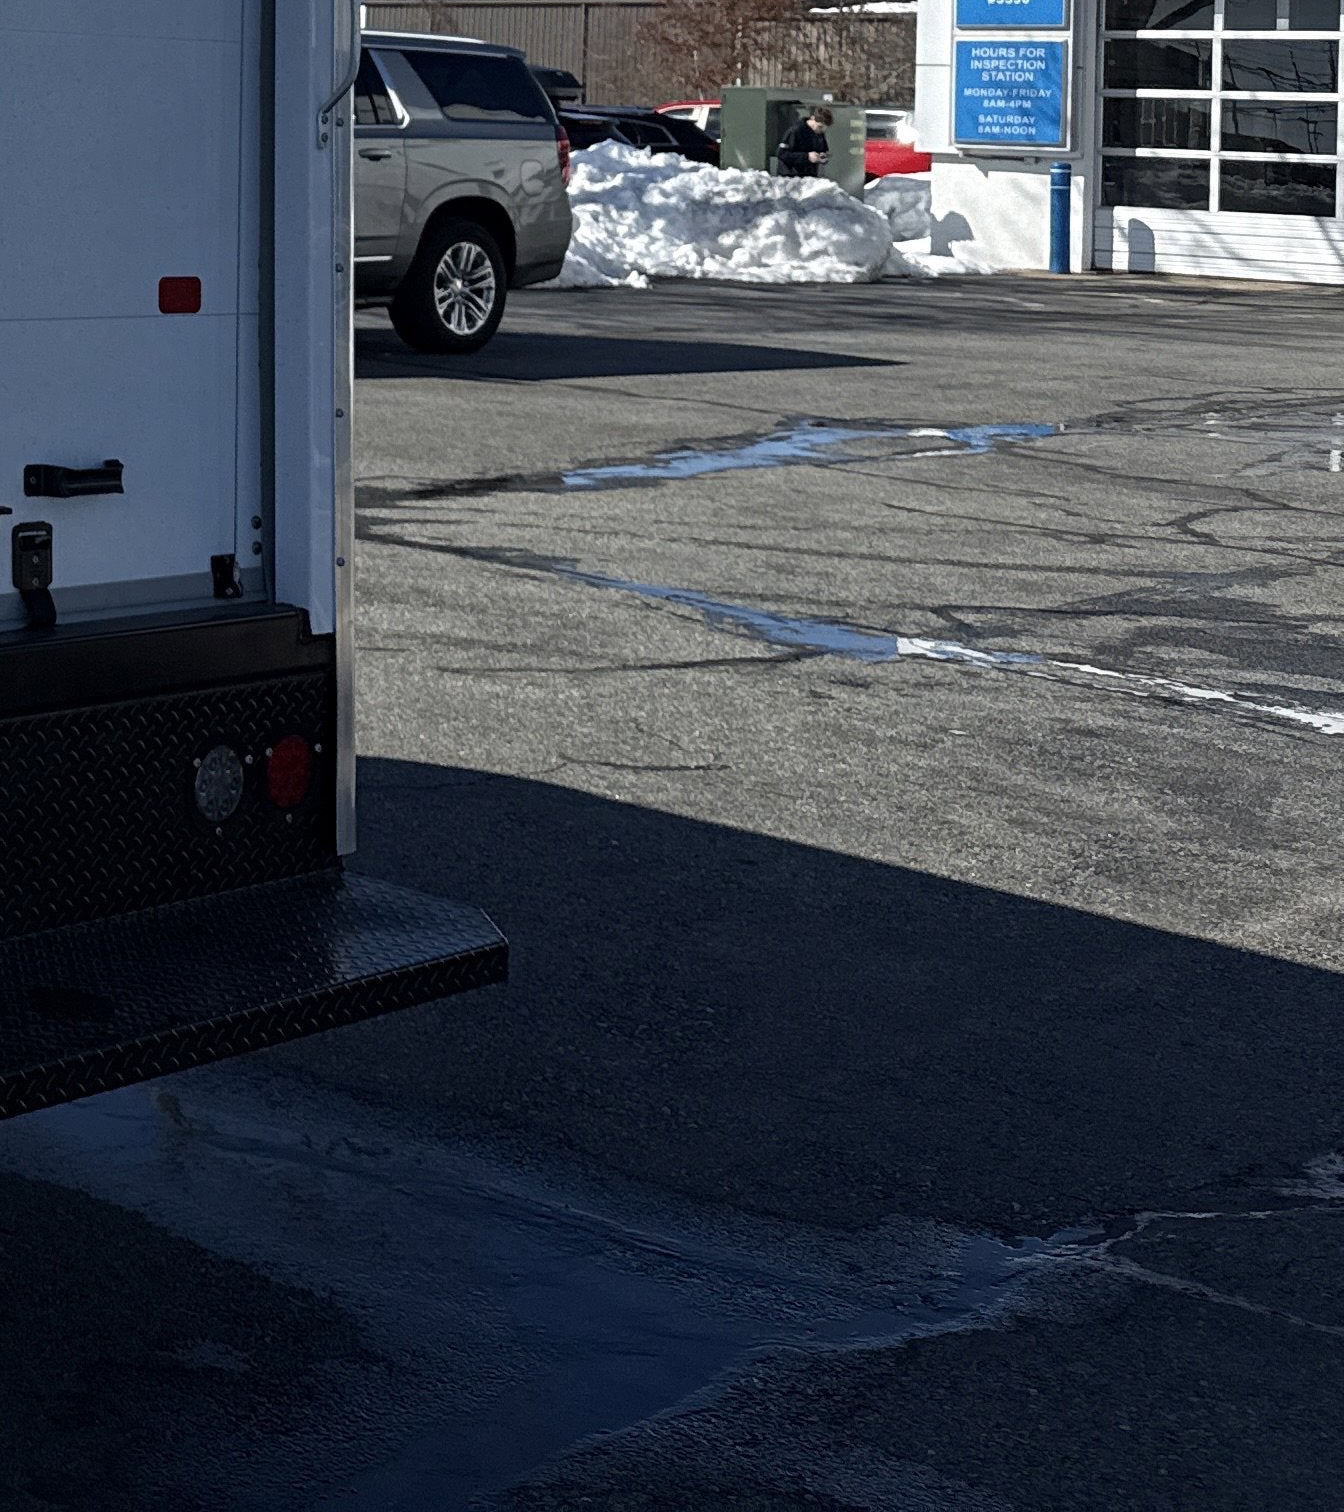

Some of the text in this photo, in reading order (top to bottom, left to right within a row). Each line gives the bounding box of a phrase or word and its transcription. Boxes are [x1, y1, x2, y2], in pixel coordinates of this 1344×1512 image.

[971, 48, 1045, 58] HOURS FOR
[970, 59, 1046, 69] INSPECTION
[981, 71, 1034, 82] STATION
[978, 114, 1036, 124] SATURDAY
